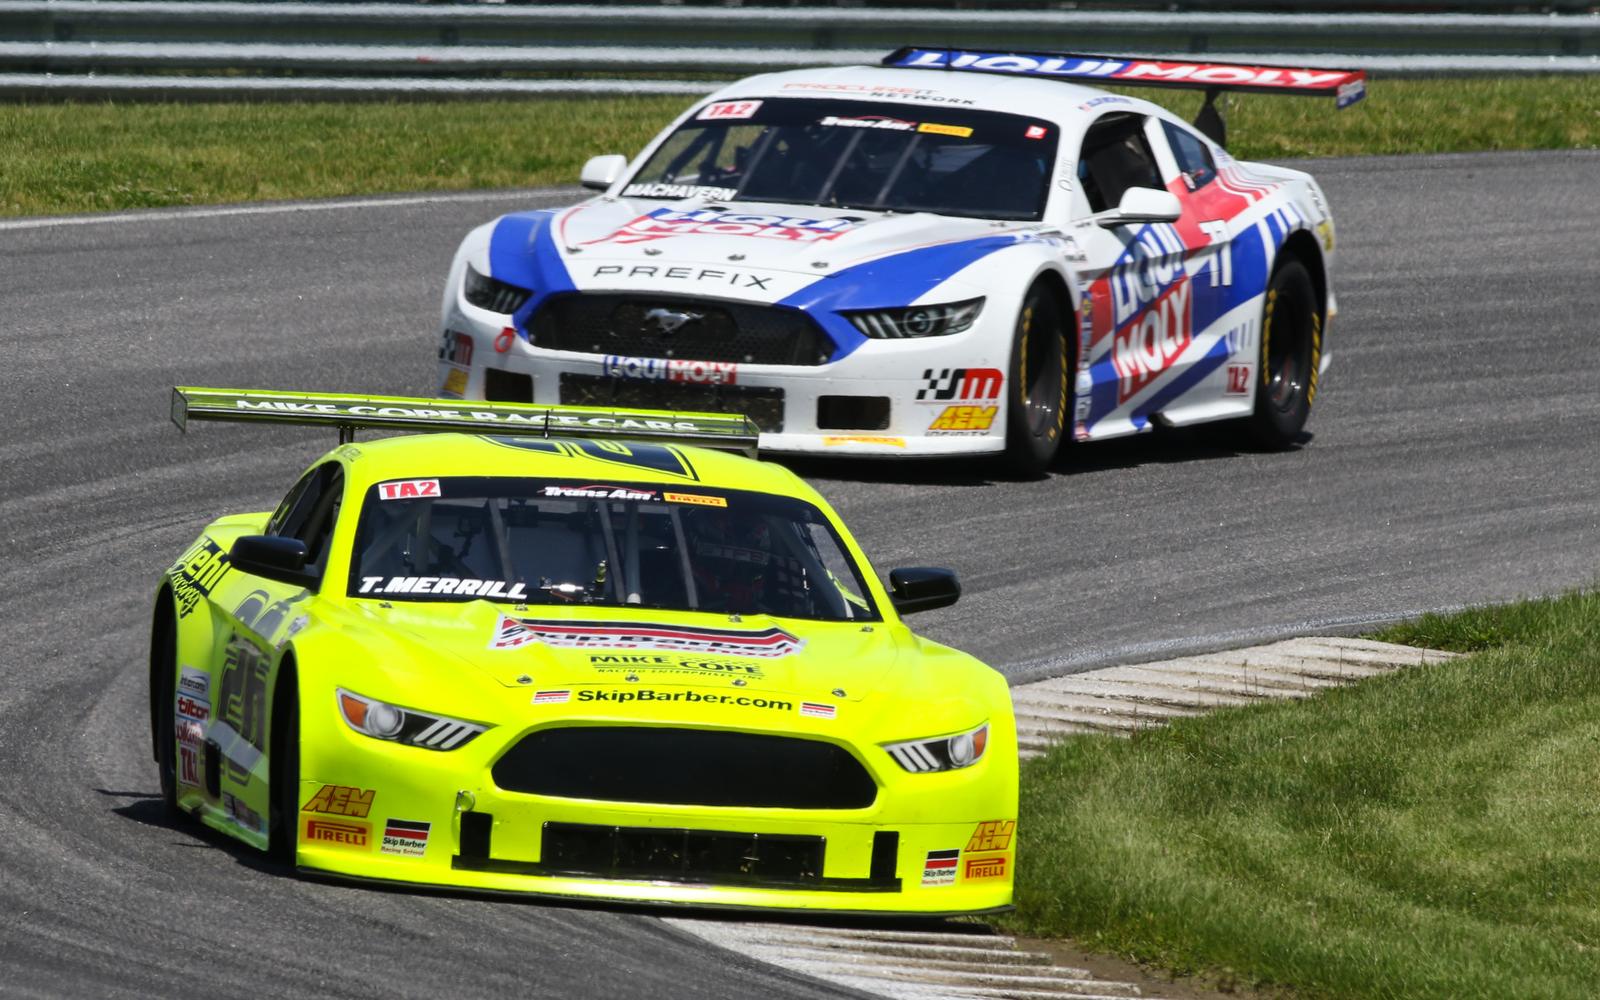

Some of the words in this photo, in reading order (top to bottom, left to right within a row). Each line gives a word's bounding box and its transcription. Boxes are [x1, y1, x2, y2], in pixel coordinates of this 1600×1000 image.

[908, 51, 1126, 78] LIQUI
[1114, 63, 1348, 87] MOLY
[621, 183, 739, 202] MACHAVERN
[623, 218, 830, 241] MOLY
[651, 209, 855, 231] LIQUI
[592, 265, 773, 291] PREFIX
[1110, 221, 1185, 325] LIQUI
[1116, 280, 1192, 396] MOLY
[603, 355, 668, 380] LIQUI
[668, 358, 732, 384] MOLY
[235, 400, 339, 414] MIKE
[348, 406, 461, 420] COPE
[470, 411, 582, 425] RACE
[587, 417, 699, 431] CARS
[927, 405, 999, 431] AEM
[381, 480, 440, 499] TA2
[544, 486, 609, 498] Trans
[607, 488, 652, 501] Am
[358, 576, 528, 600] T.MERRILL
[590, 656, 671, 664] MIKE
[679, 661, 763, 675] COPE
[577, 689, 793, 711] SkipBarber.com
[301, 784, 376, 819] AEM
[307, 819, 367, 847] PIRELLI
[383, 836, 399, 847] Skip
[399, 838, 426, 849] Barber
[963, 820, 1016, 853] AEM
[965, 857, 1006, 879] PIRELLI
